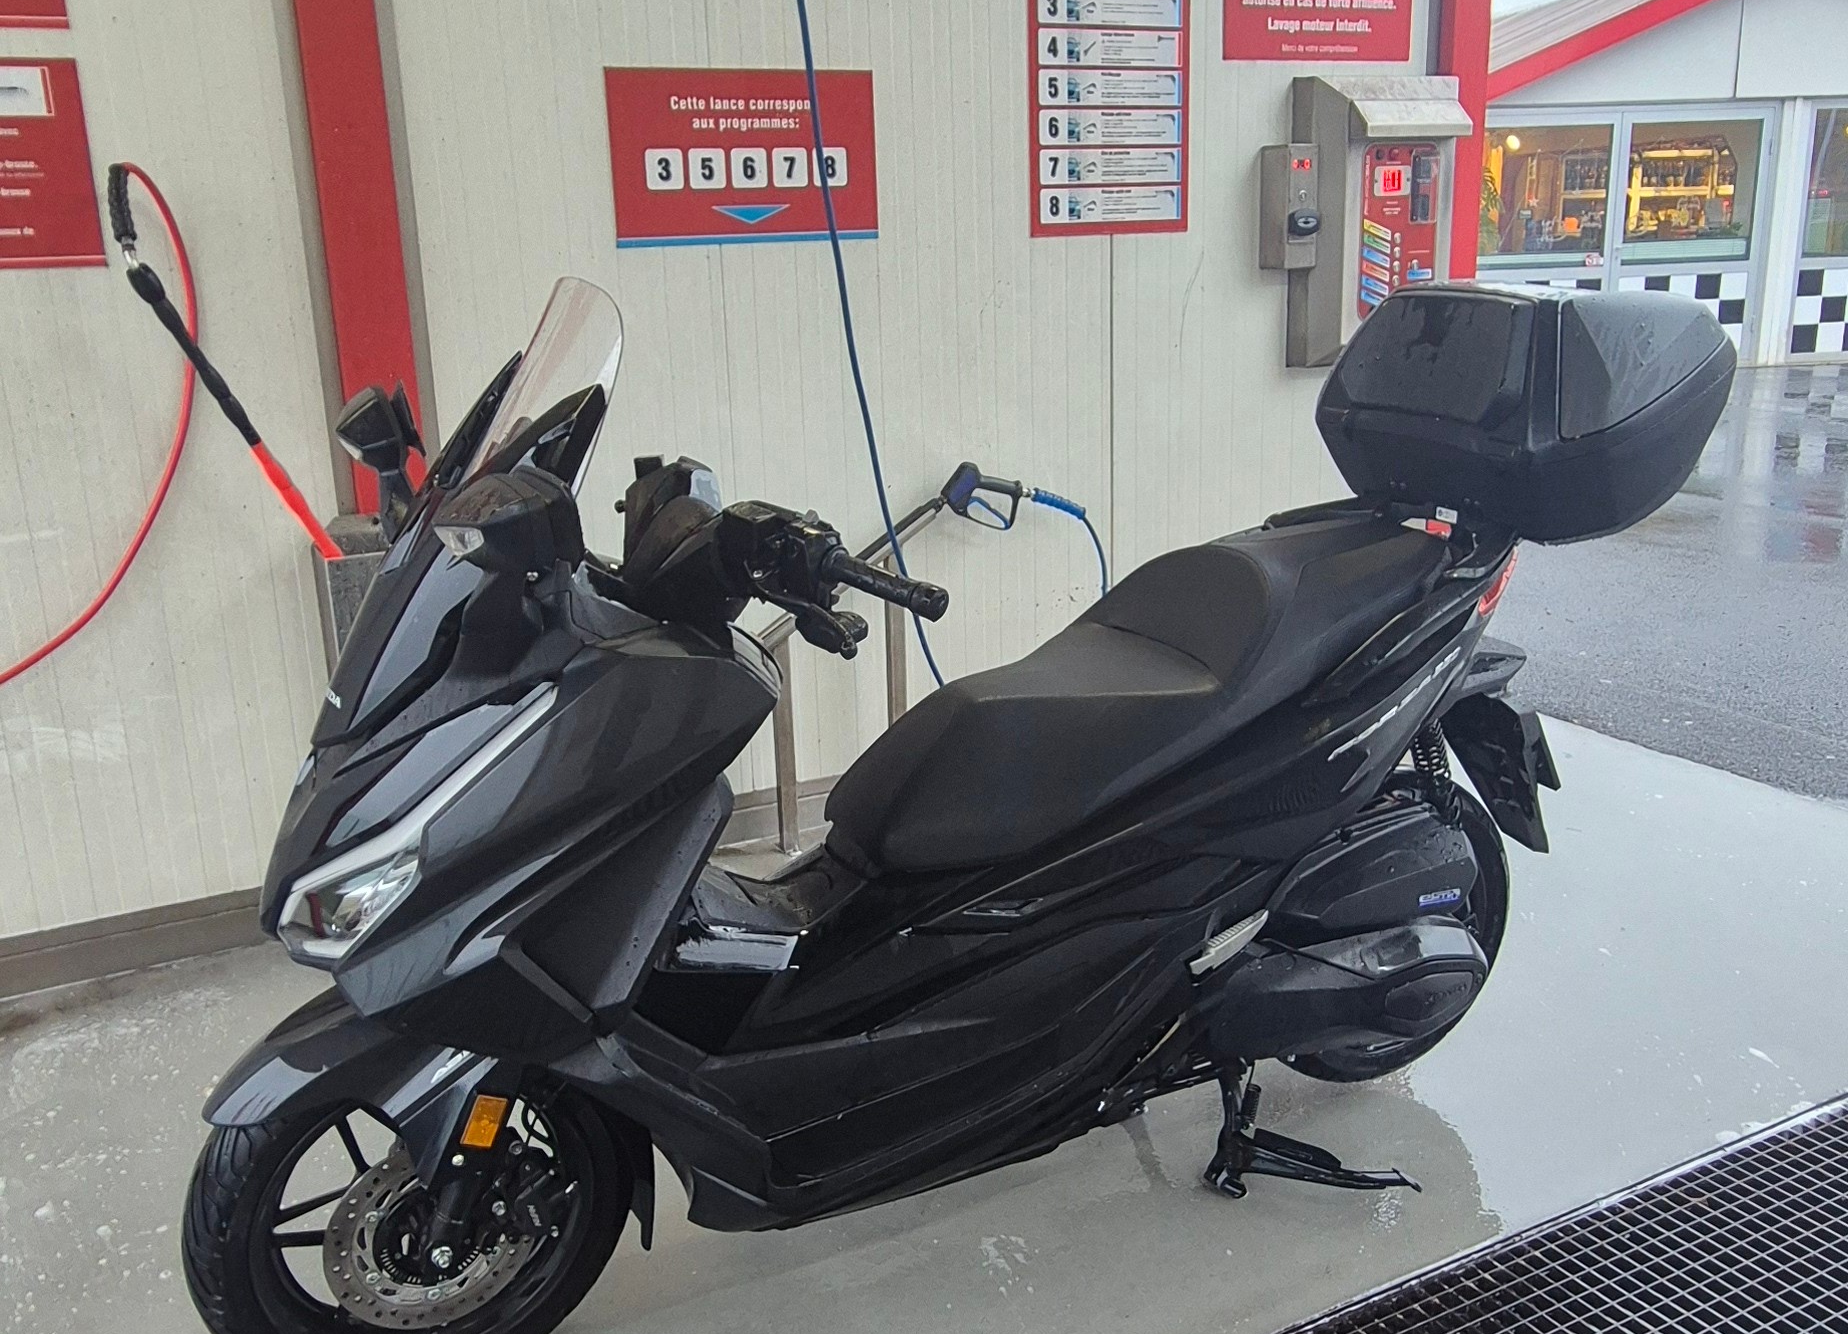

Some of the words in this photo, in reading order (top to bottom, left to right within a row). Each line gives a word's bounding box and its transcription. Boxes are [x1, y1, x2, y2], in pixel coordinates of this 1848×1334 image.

[1267, 16, 1301, 33] Lavage
[1302, 19, 1334, 32] moteur
[1047, 36, 1058, 58] 4
[1048, 77, 1059, 99] 5
[670, 95, 706, 110] Cette
[710, 95, 745, 110] lance
[749, 98, 811, 113] correspon
[692, 118, 715, 129] aux
[719, 117, 800, 131] programmes:
[1048, 116, 1059, 138] 6
[657, 157, 672, 182] 3
[700, 157, 714, 181] 5
[742, 156, 756, 180] 6
[782, 156, 796, 179] 7
[823, 155, 837, 179] 8
[1048, 156, 1059, 178] 7
[1049, 195, 1060, 217] 8
